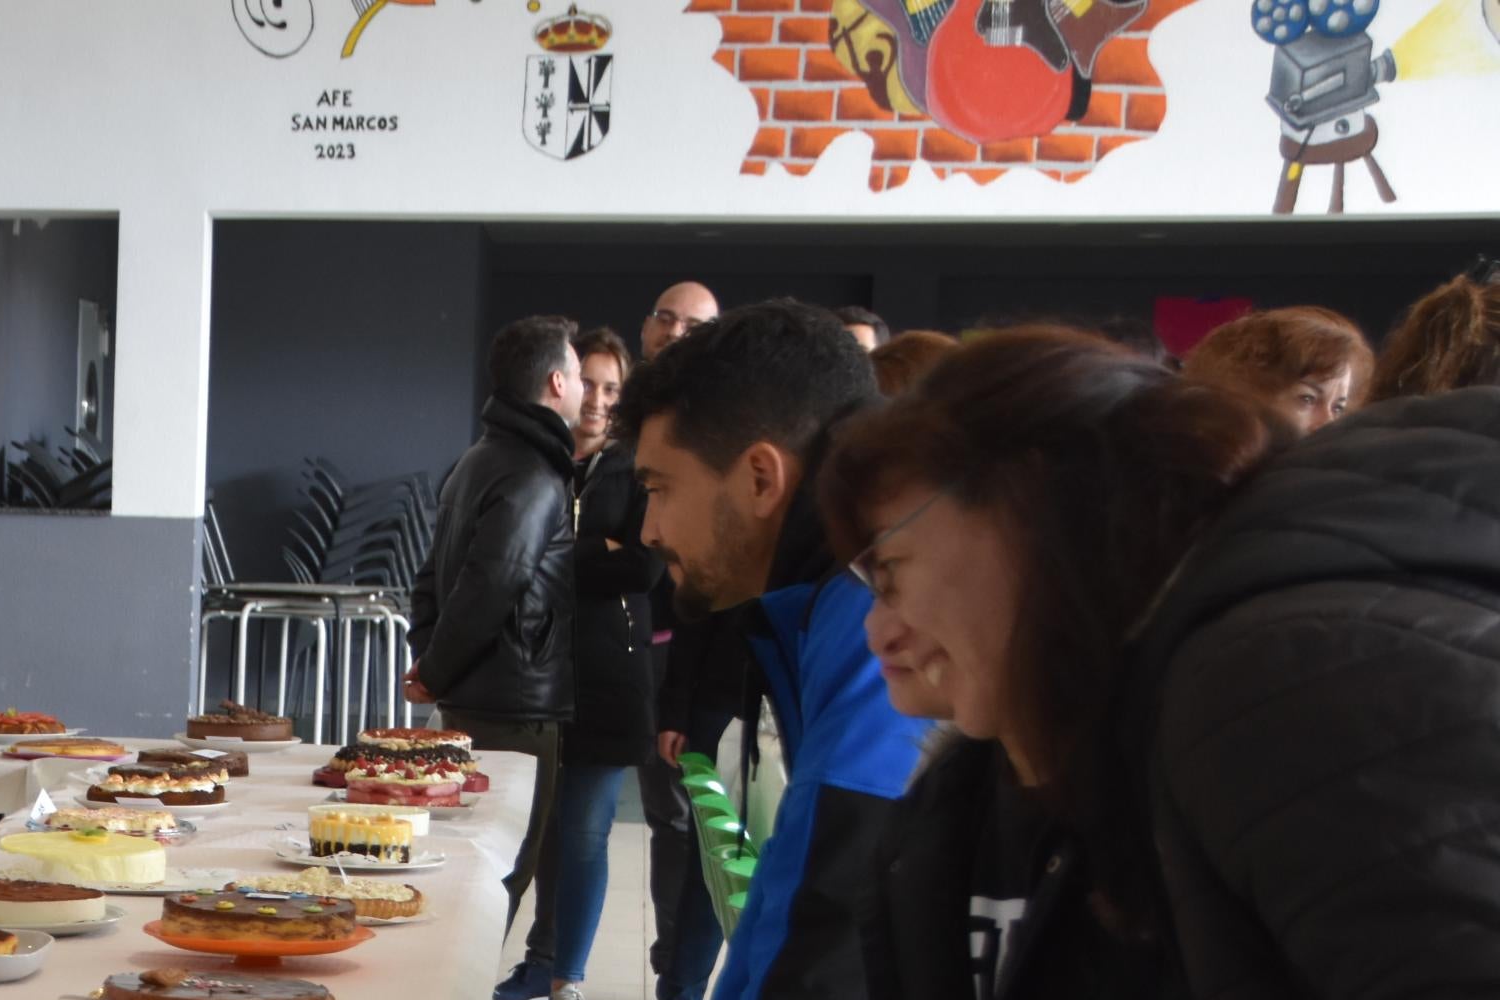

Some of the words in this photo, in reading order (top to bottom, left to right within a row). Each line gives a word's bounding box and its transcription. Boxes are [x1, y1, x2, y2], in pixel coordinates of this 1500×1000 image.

[316, 89, 353, 107] AFE
[291, 113, 327, 131] SAN
[332, 115, 398, 132] MARCOS
[314, 142, 356, 159] 2023
